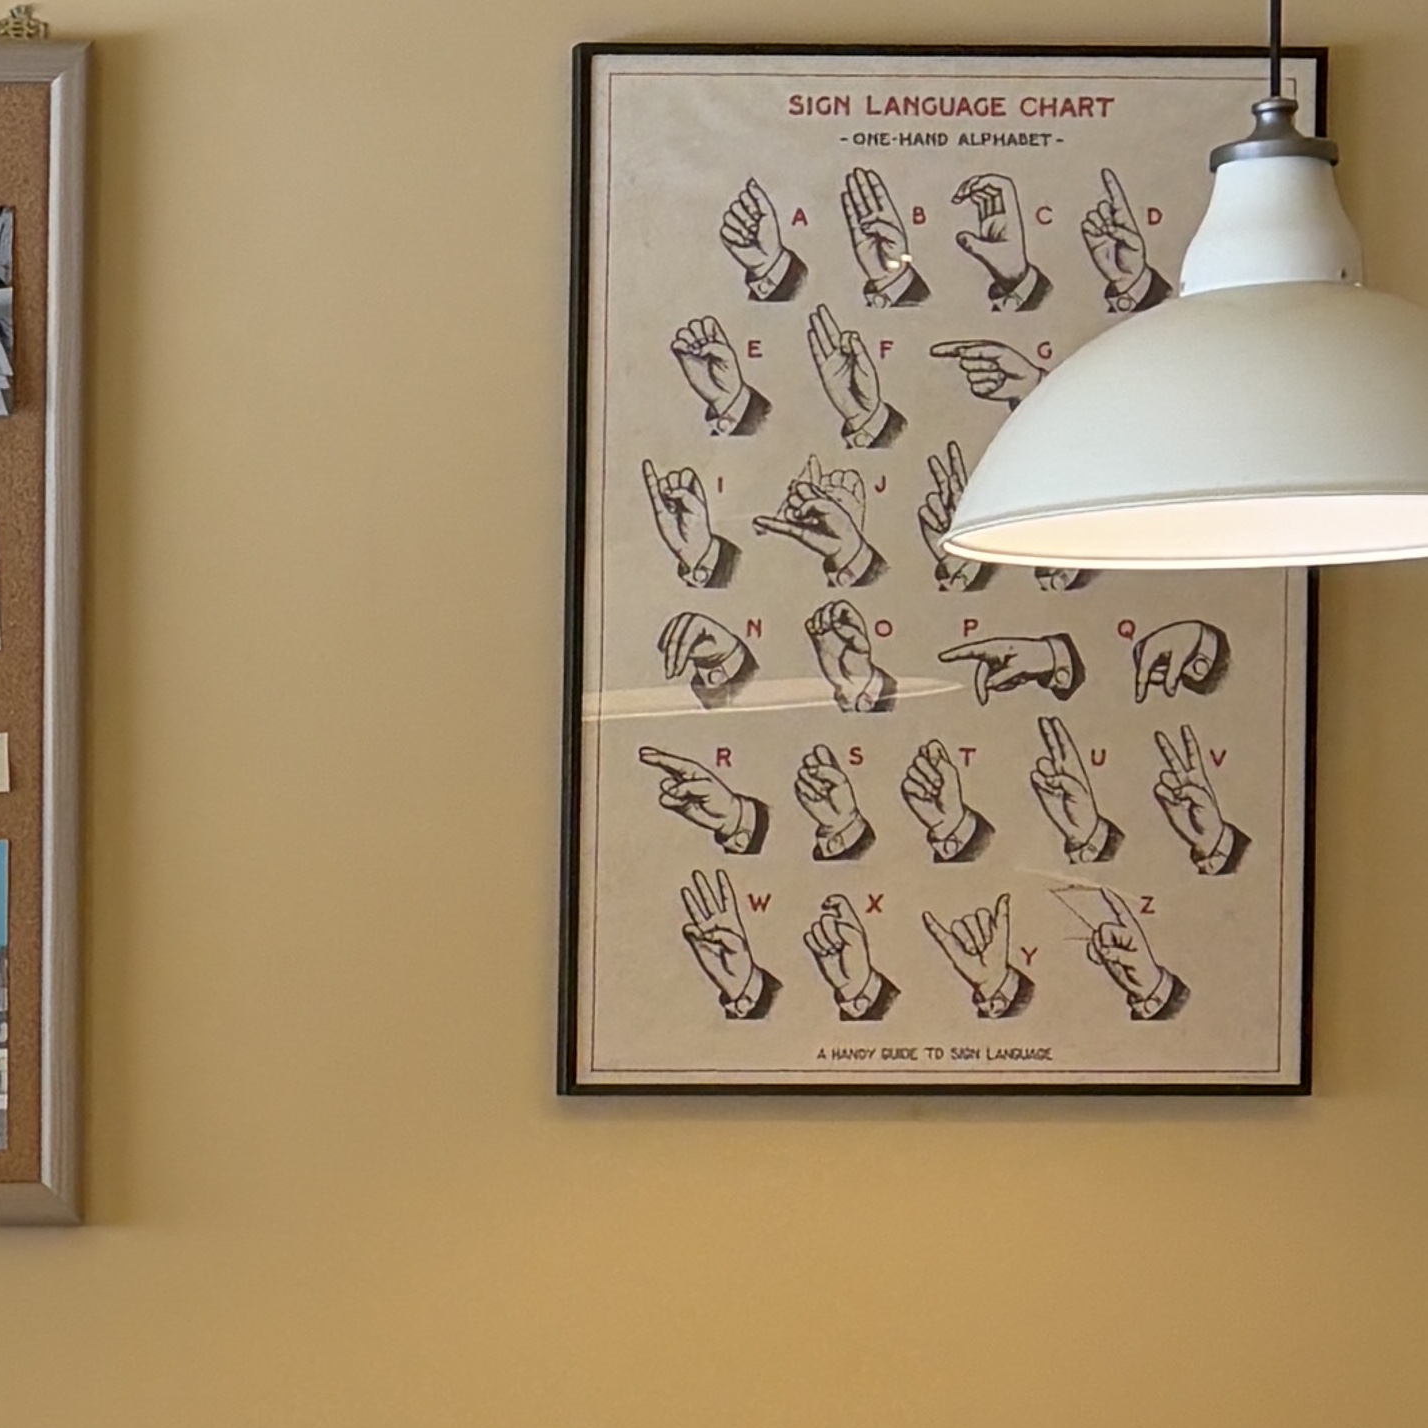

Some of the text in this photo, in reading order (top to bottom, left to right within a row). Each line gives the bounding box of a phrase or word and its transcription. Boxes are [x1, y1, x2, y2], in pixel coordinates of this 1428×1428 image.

[788, 95, 1115, 118] SIGN LANGUAGE CHART
[791, 207, 808, 227] A
[912, 207, 926, 225] B
[1037, 206, 1054, 226] C
[1148, 207, 1163, 226] D
[747, 340, 762, 358] E
[880, 340, 893, 358] F
[1038, 341, 1053, 360] G
[747, 619, 762, 638] N
[875, 620, 893, 638] O
[964, 619, 978, 637] P
[1117, 619, 1136, 640] Q
[716, 748, 731, 767] R
[850, 747, 863, 767] S
[959, 747, 976, 767] T
[1091, 749, 1106, 768] U
[1210, 749, 1227, 768] V
[748, 894, 771, 913] W
[866, 894, 883, 913] X
[1141, 896, 1155, 914] Z
[1022, 947, 1038, 966] Y
[832, 1048, 876, 1060] HANDY
[924, 1048, 944, 1059] TO
